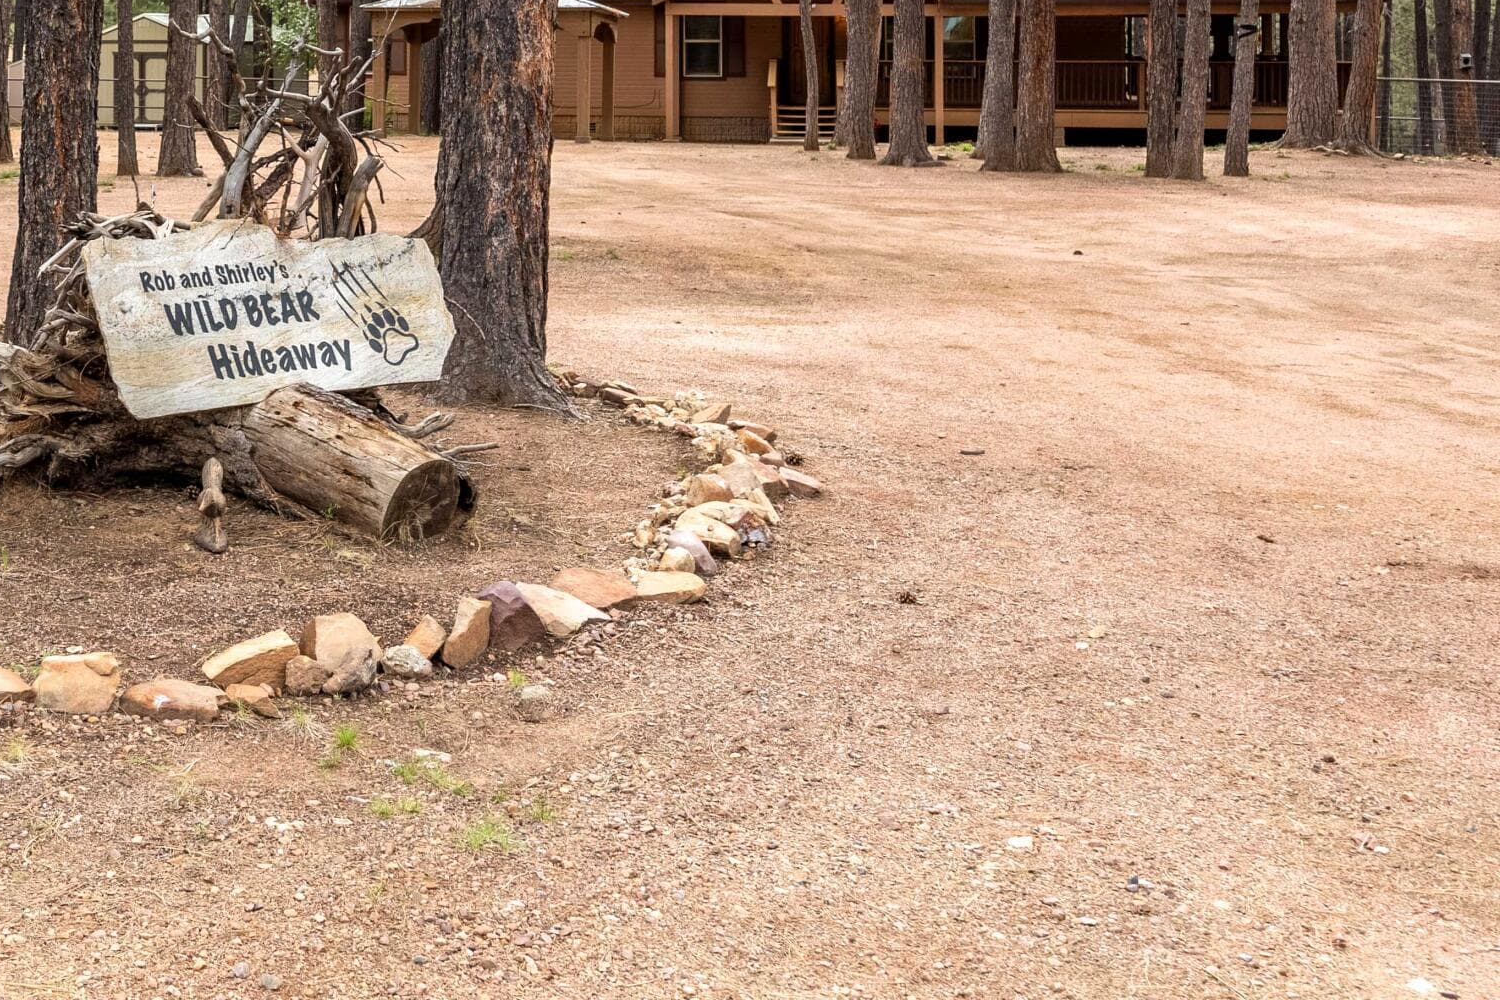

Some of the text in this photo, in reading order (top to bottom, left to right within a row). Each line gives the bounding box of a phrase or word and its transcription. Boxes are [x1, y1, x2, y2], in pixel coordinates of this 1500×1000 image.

[139, 260, 289, 293] Rob and Shirley's
[163, 290, 321, 336] WILD BEAR
[207, 338, 352, 380] Hideaway
